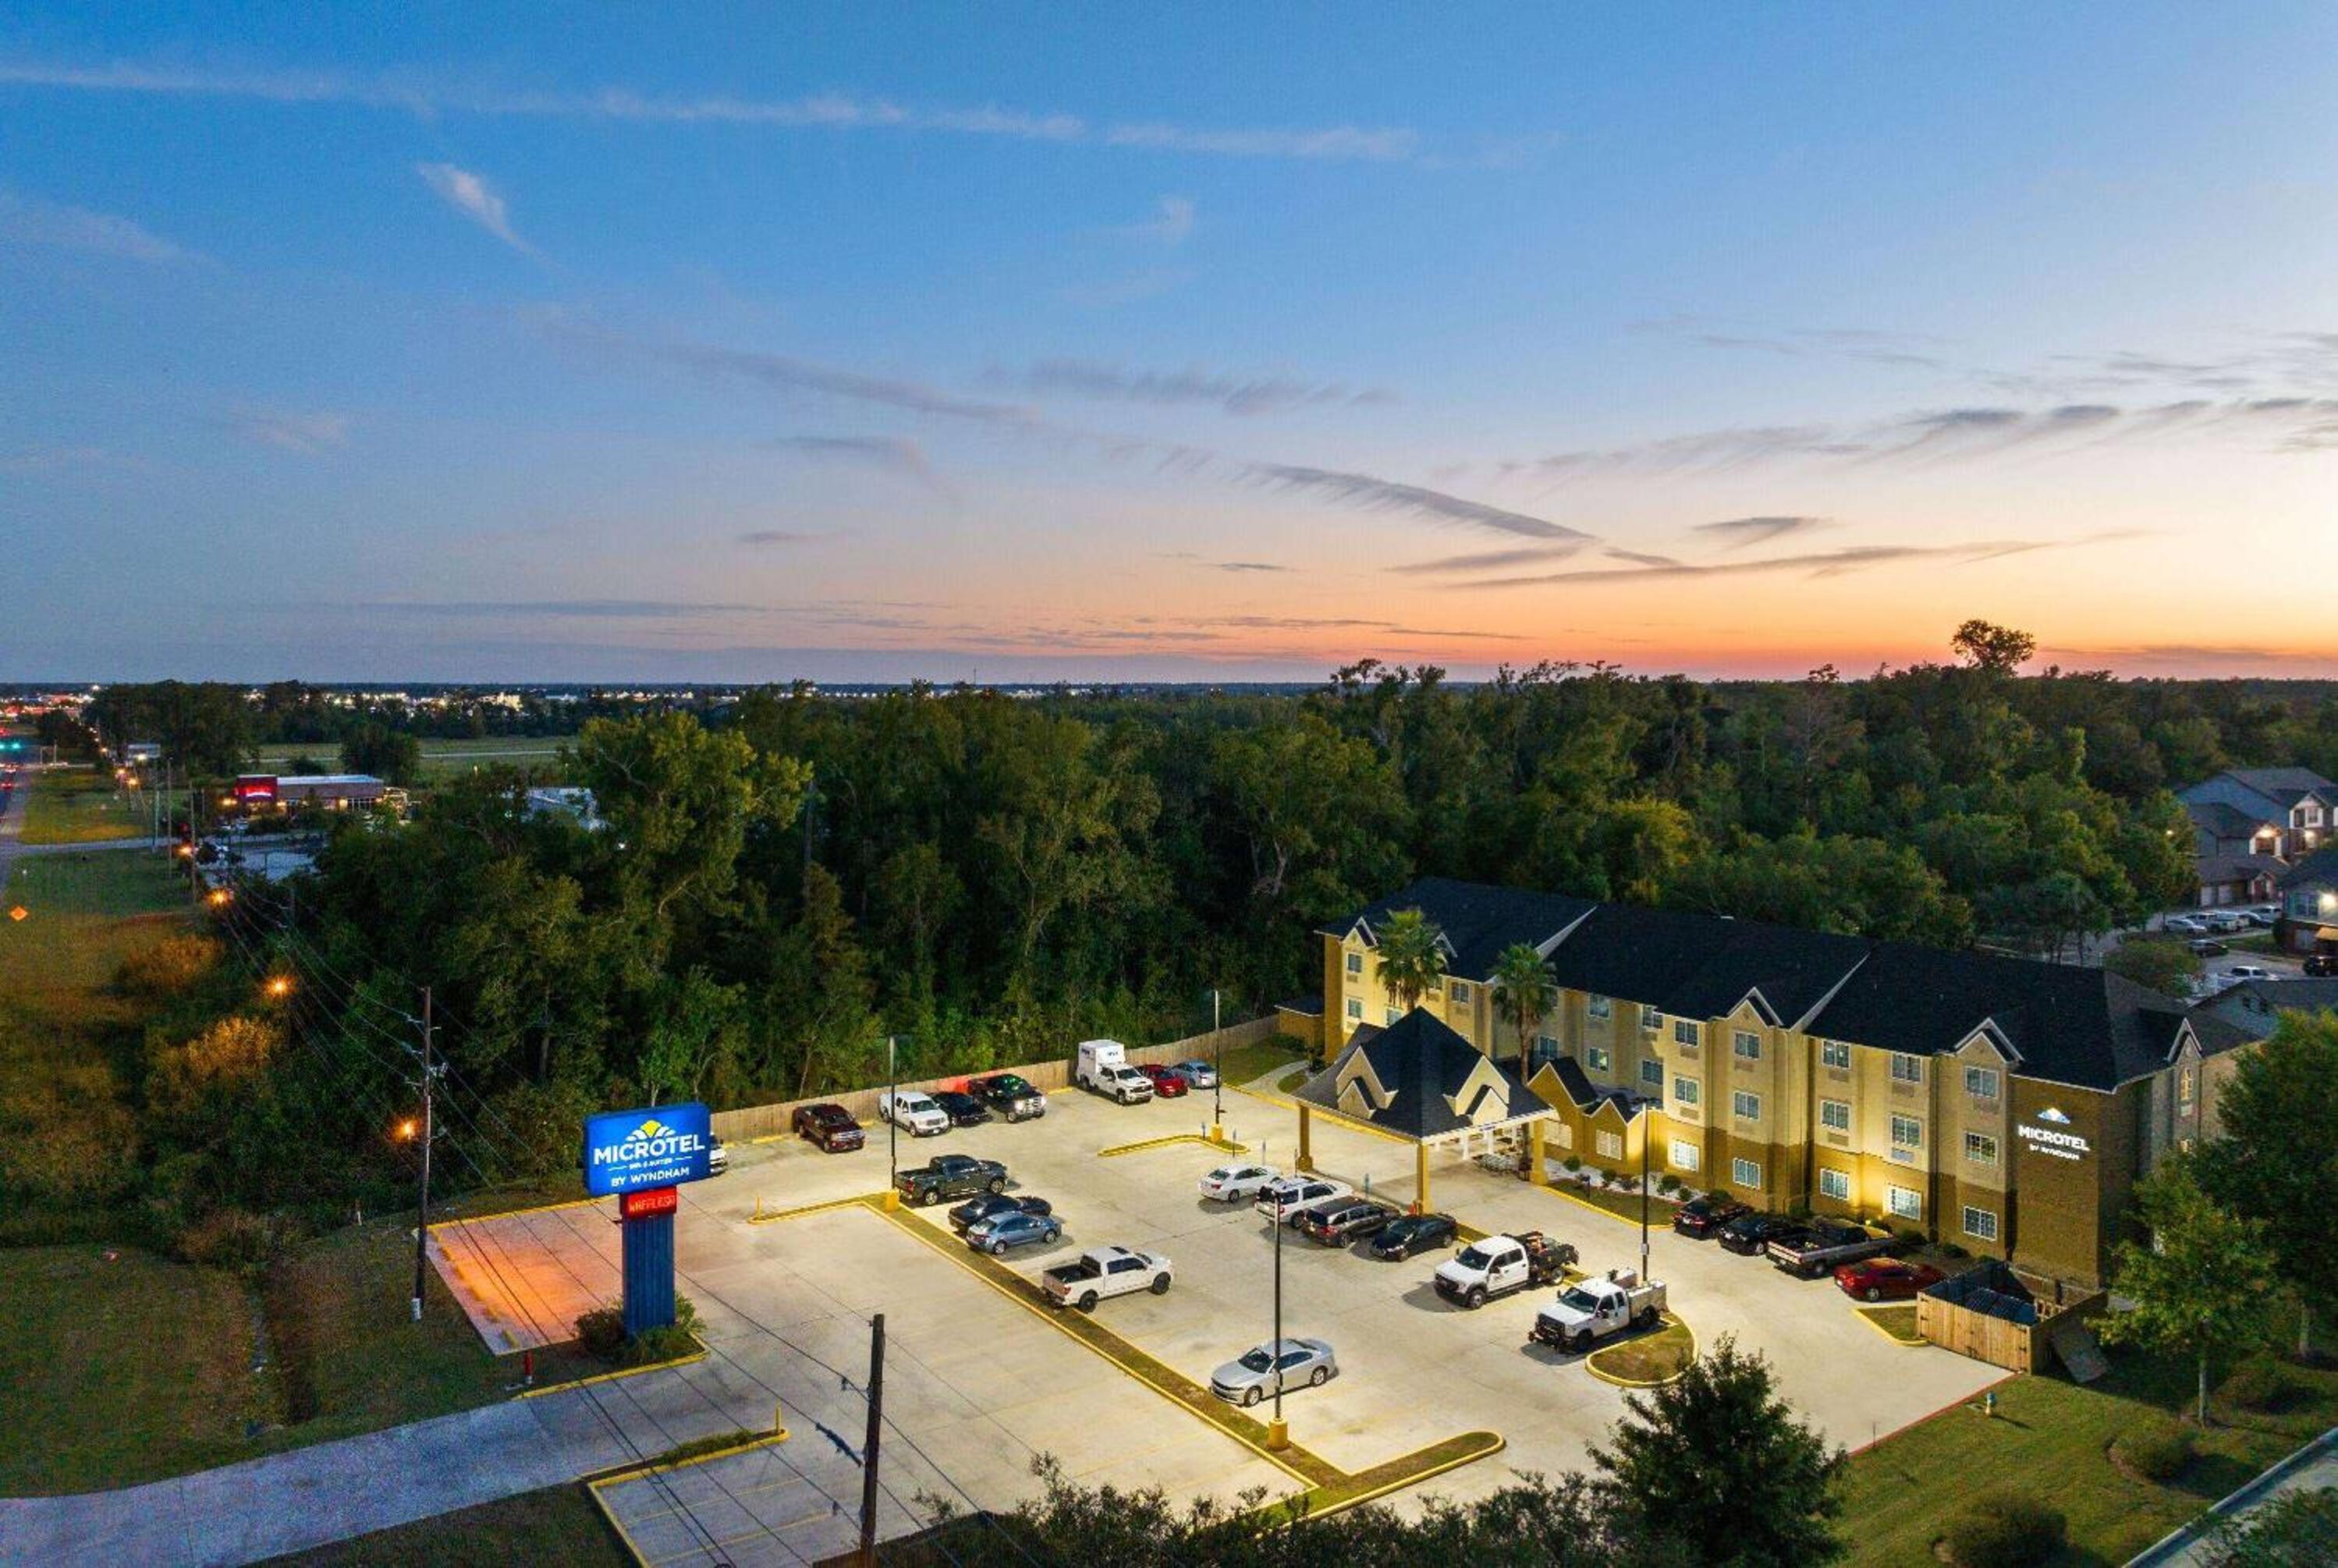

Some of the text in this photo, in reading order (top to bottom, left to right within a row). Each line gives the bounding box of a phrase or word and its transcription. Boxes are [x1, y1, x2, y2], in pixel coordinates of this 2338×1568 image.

[594, 1134, 705, 1165] MICROTEL
[2018, 1124, 2091, 1151] MICROTEL
[611, 1167, 690, 1187] BY WYNDHAM
